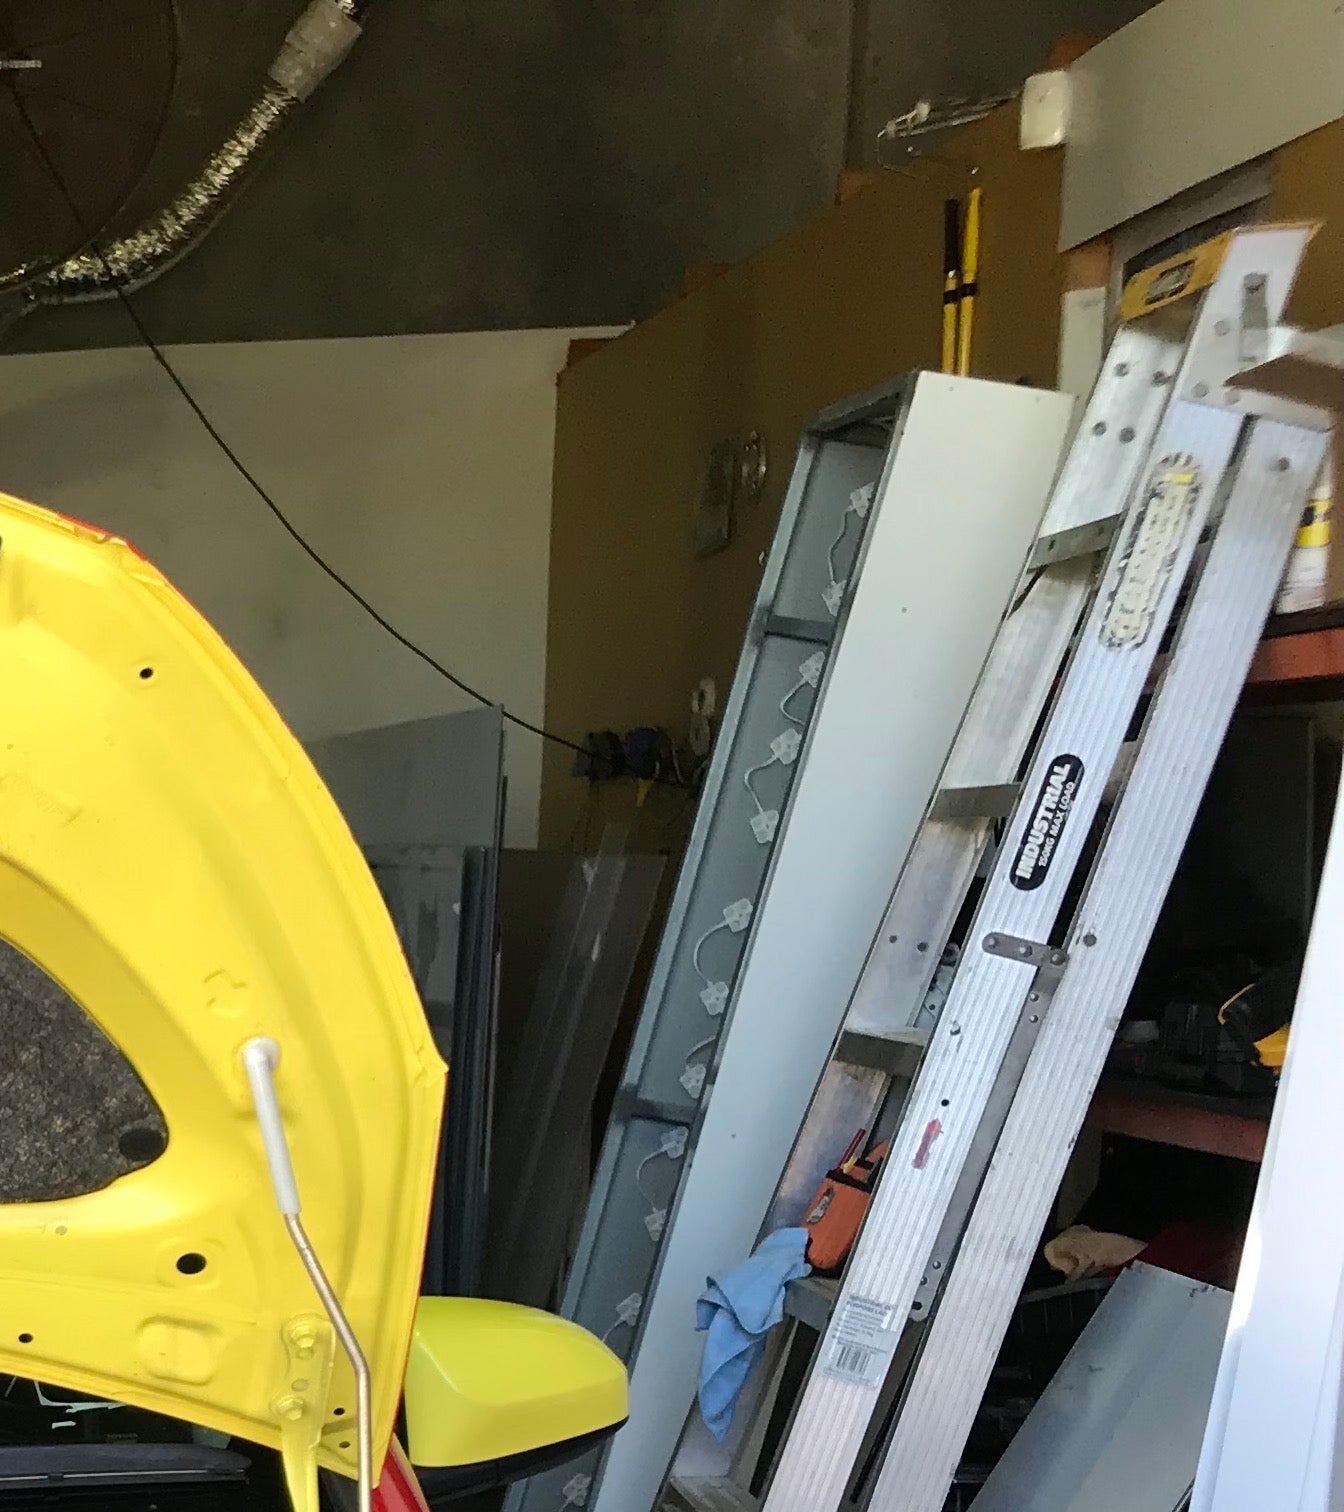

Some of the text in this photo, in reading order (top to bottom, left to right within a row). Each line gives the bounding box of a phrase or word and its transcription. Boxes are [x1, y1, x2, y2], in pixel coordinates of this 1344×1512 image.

[1015, 763, 1071, 880] INDUSTRIAL
[1038, 781, 1075, 867] 150KG MAX LOAD
